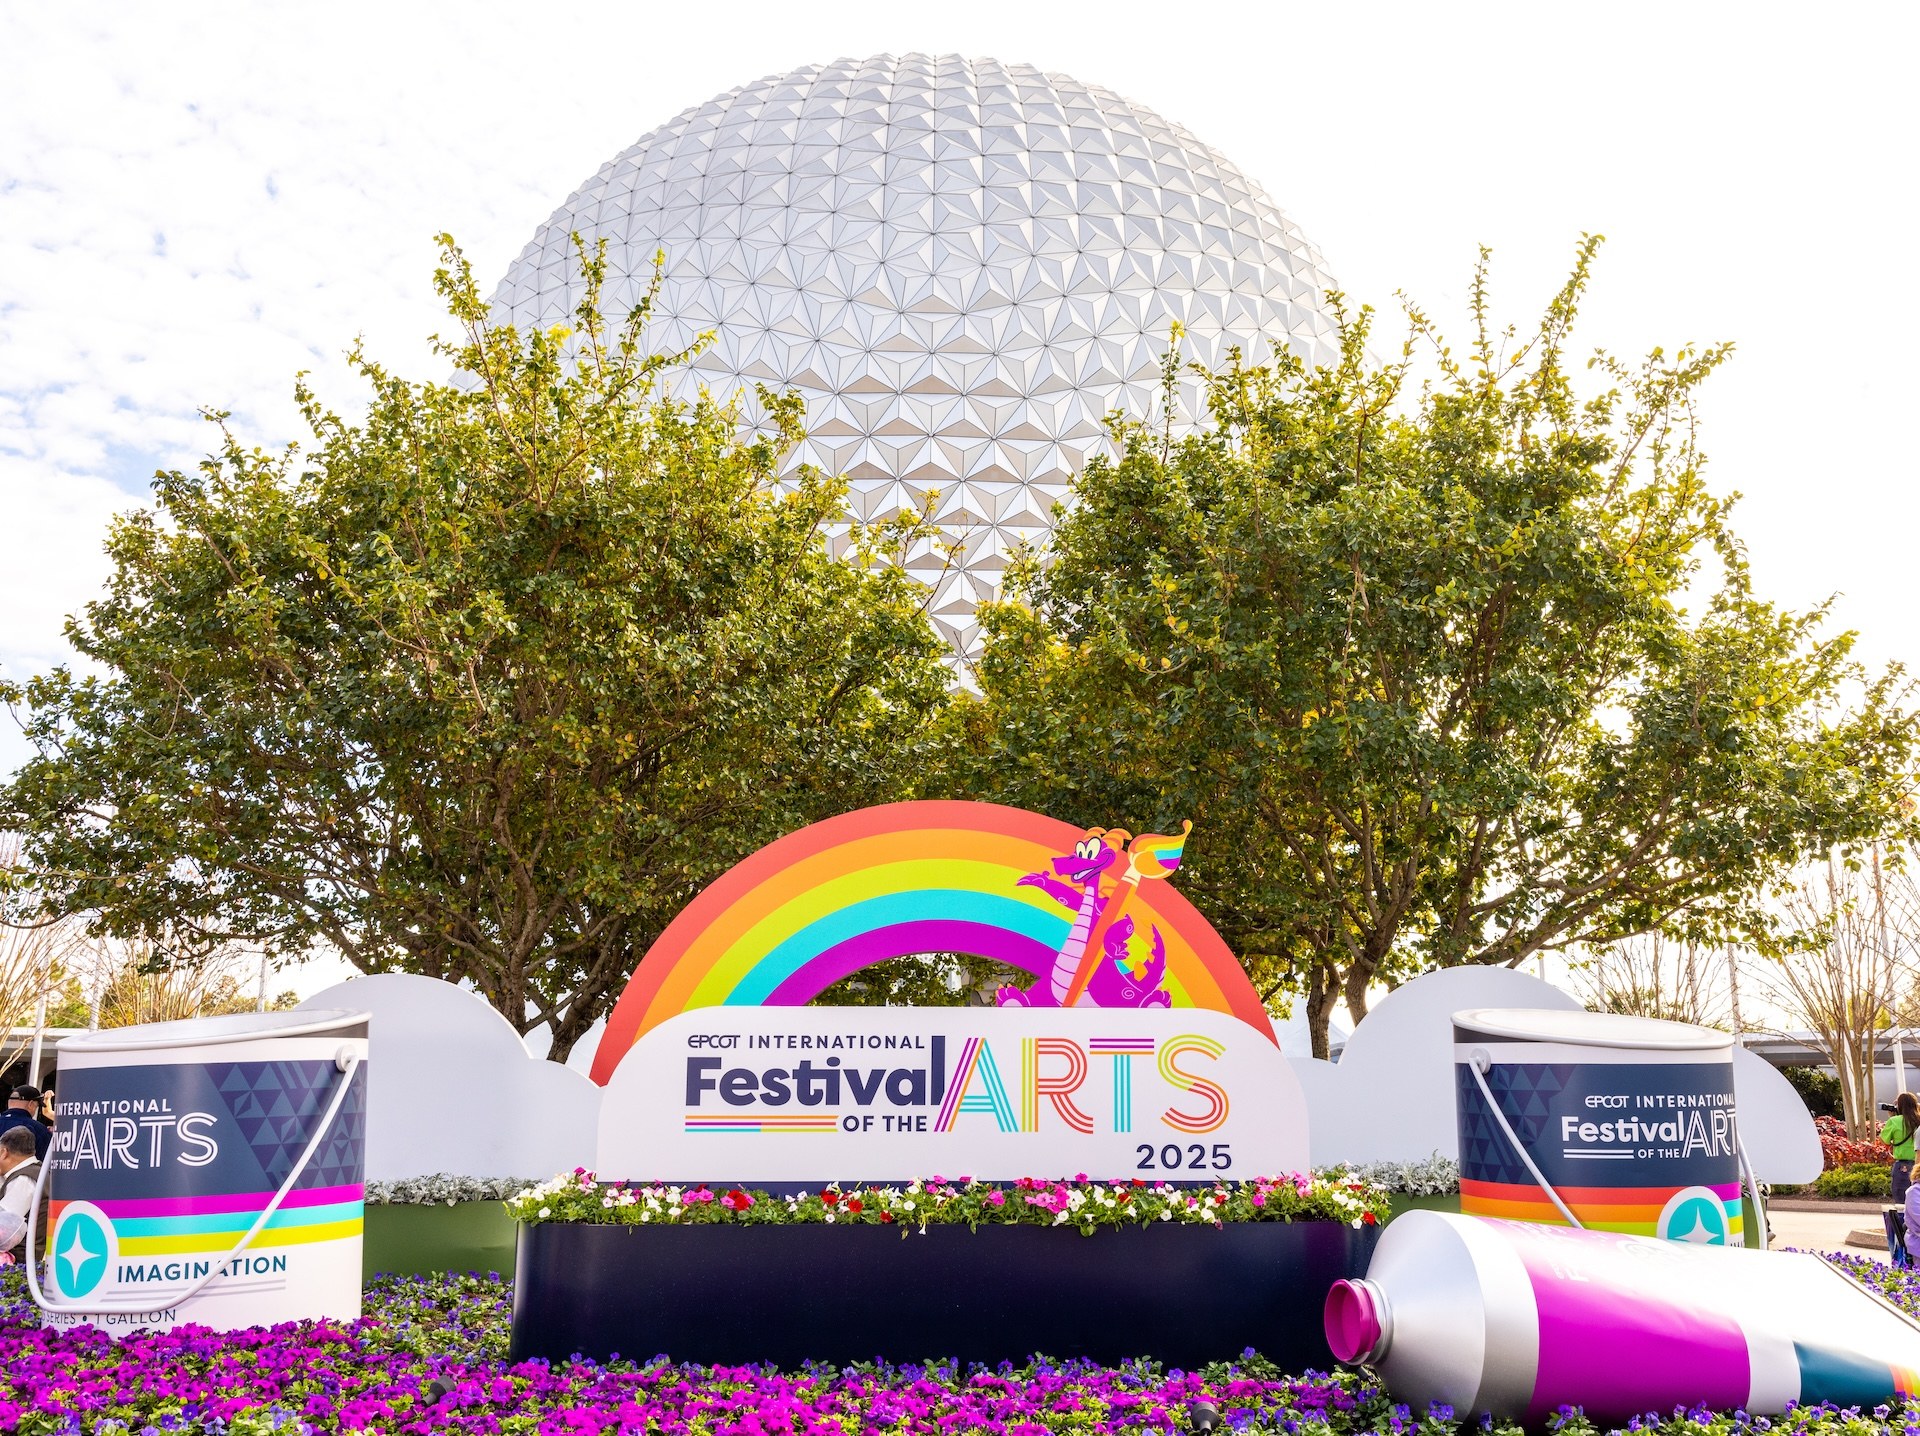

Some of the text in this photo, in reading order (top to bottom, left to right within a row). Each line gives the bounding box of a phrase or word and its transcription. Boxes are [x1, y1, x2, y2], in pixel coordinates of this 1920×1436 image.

[687, 1034, 925, 1049] EPCOT INTERNATIONAL
[685, 1034, 1229, 1134] Festival ARTS
[56, 1099, 172, 1116] INTERNATIONAL
[1585, 1094, 1735, 1108] EPCOT INTERNATIONAL
[842, 1115, 927, 1132] OF THE
[71, 1112, 218, 1170] ARTS
[1561, 1108, 1737, 1158] Festival ART
[1136, 1144, 1232, 1169] 2025
[1638, 1149, 1680, 1159] OF THE
[59, 1159, 71, 1170] THE
[46, 1312, 76, 1325] SERIES
[106, 1309, 176, 1325] GALLON
